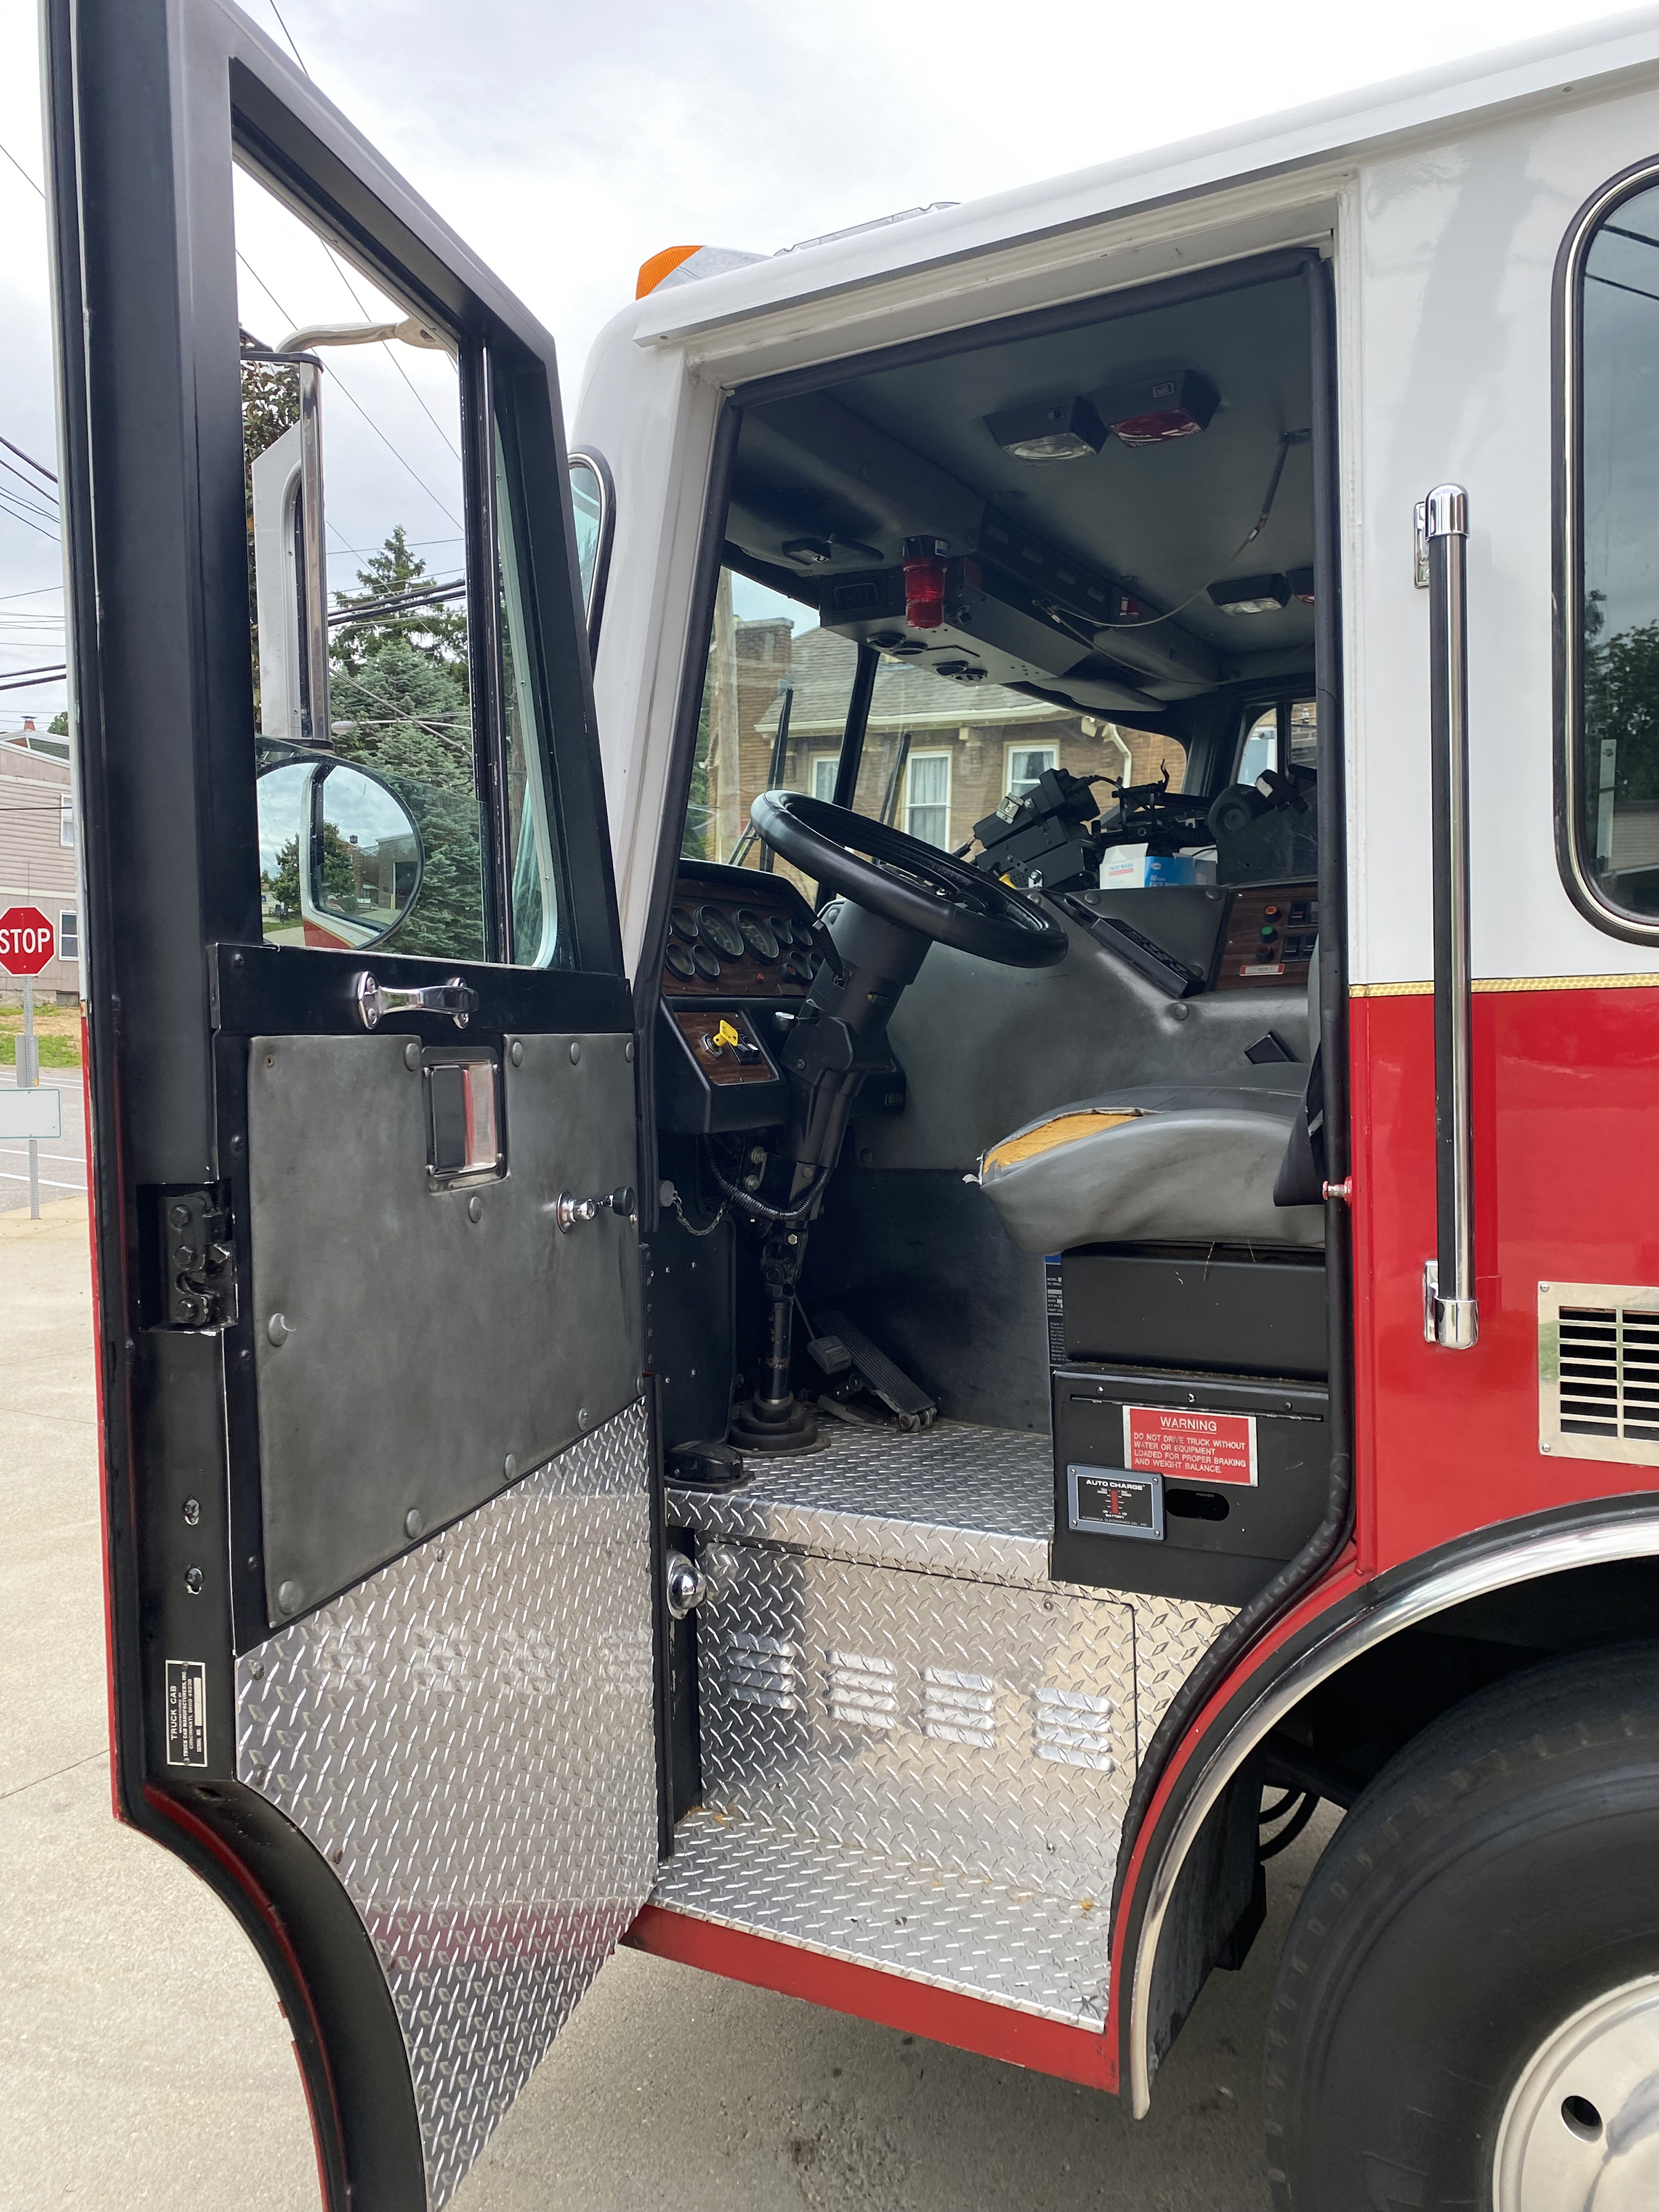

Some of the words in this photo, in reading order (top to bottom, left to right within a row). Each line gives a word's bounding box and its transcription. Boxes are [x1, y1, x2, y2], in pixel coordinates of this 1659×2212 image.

[0, 928, 50, 954] STOP
[1160, 1416, 1217, 1432] WARNING
[1134, 1441, 1159, 1450] WATER
[1174, 1445, 1215, 1455] EQUIPMENT
[1146, 1434, 1161, 1442] NOT
[1163, 1435, 1184, 1444] DRIVE
[1186, 1438, 1210, 1447] TRUCK
[1212, 1440, 1246, 1450] WITHOUT
[1134, 1450, 1162, 1459] LOADED
[1165, 1452, 1179, 1461] FOR
[1182, 1454, 1211, 1463] PROPER
[1214, 1457, 1246, 1468] BRAKING
[1153, 1459, 1182, 1469] WEIGHT
[1109, 1482, 1143, 1491] CHARGE
